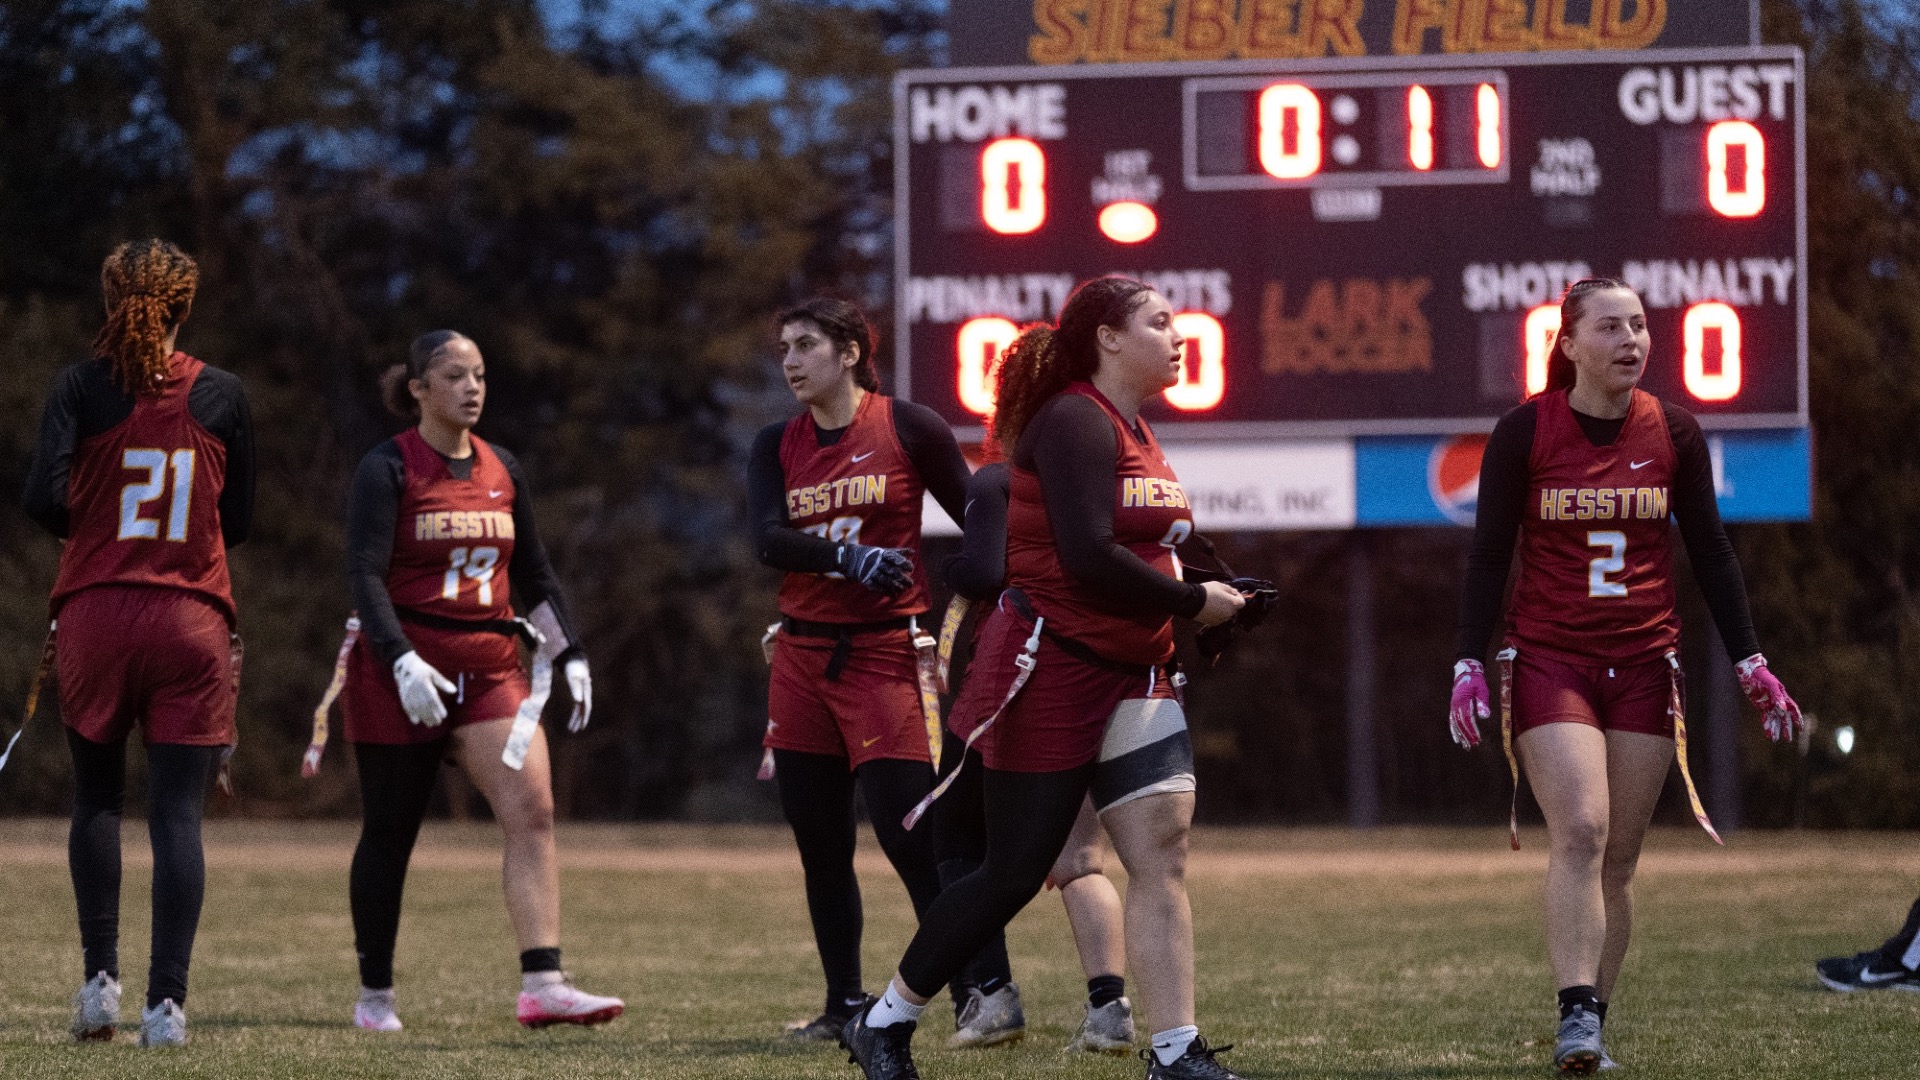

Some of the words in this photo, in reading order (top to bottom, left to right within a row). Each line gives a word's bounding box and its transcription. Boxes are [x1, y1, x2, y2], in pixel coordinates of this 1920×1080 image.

[1028, 0, 1366, 64] SIEBER
[1391, 0, 1667, 55] FIELD
[910, 84, 1068, 142] HOME
[1618, 65, 1795, 126] GUEST
[981, 137, 1047, 235] 0
[1706, 119, 1766, 218] 0
[1622, 257, 1794, 308] PENALTY
[1683, 301, 1742, 401] 0
[118, 448, 195, 542] 21
[786, 475, 887, 520] ESSTON
[1540, 487, 1668, 520] HESSTON
[442, 546, 499, 606] 19
[1586, 529, 1629, 598] 2
